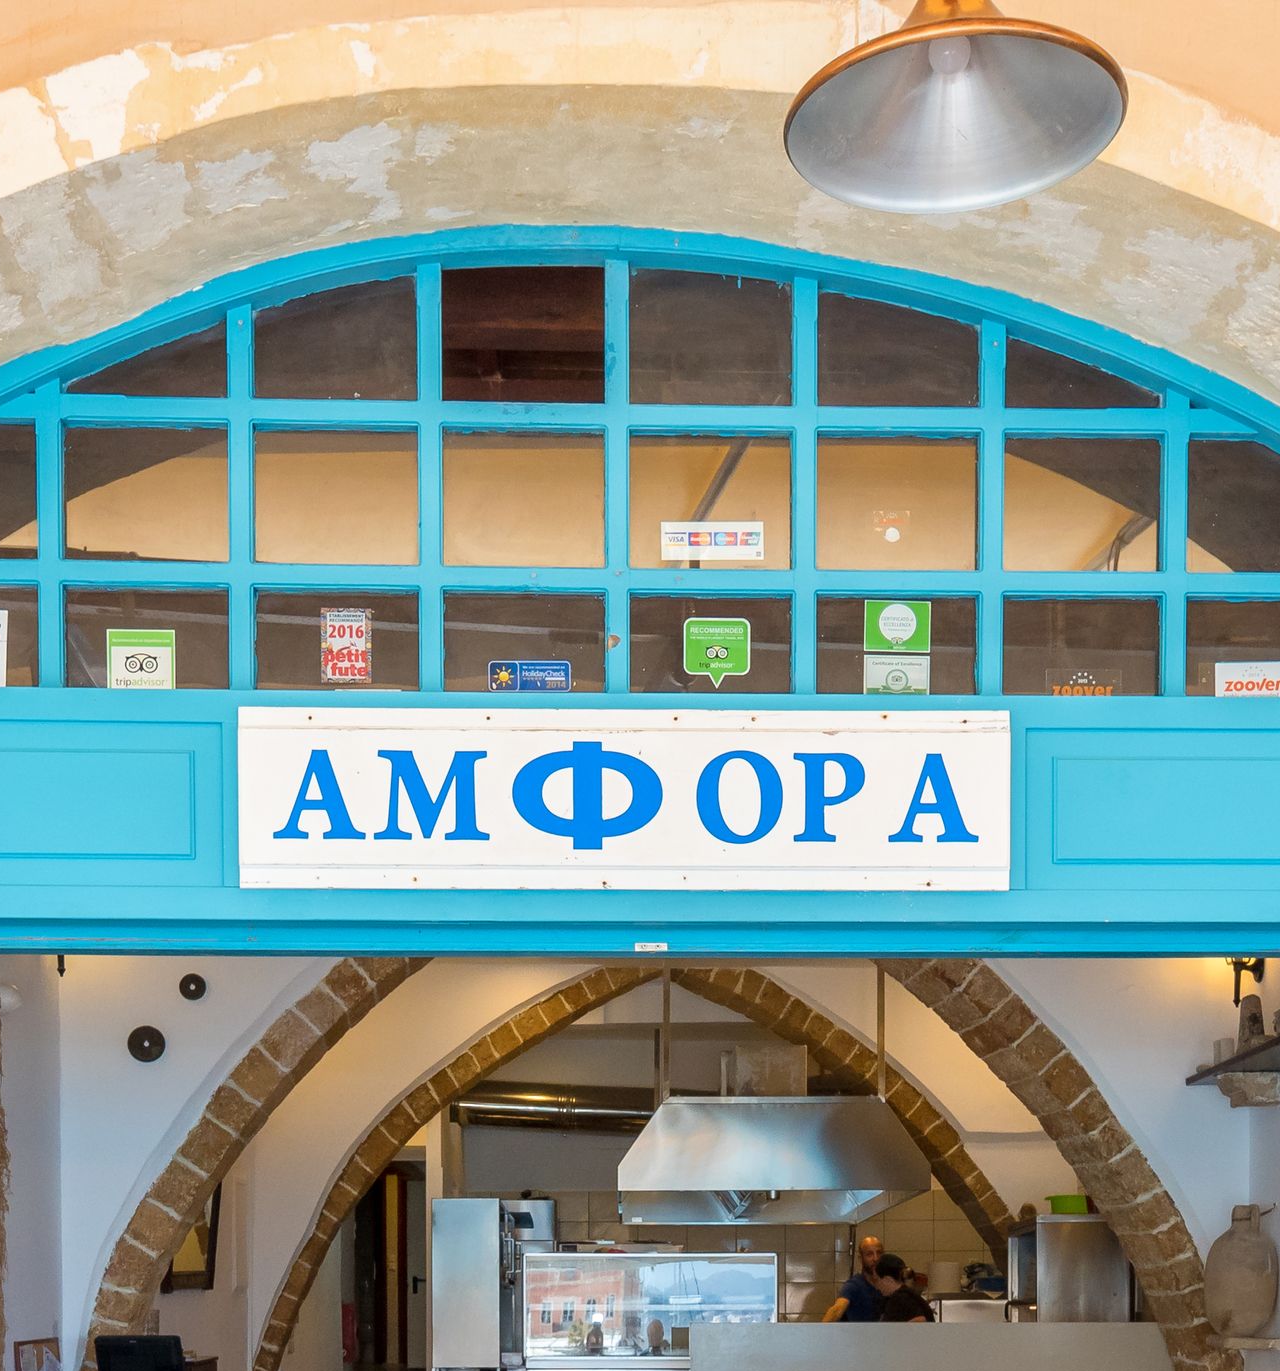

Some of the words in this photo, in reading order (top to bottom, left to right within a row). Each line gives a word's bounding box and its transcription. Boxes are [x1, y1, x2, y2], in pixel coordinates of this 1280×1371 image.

[328, 624, 364, 638] 2016
[323, 649, 368, 666] petit
[522, 670, 565, 679] HolidayCheck
[115, 677, 165, 687] tripadvisor
[1053, 685, 1113, 696] zoover
[273, 741, 979, 850] ΑΜΦΟΡΑ
